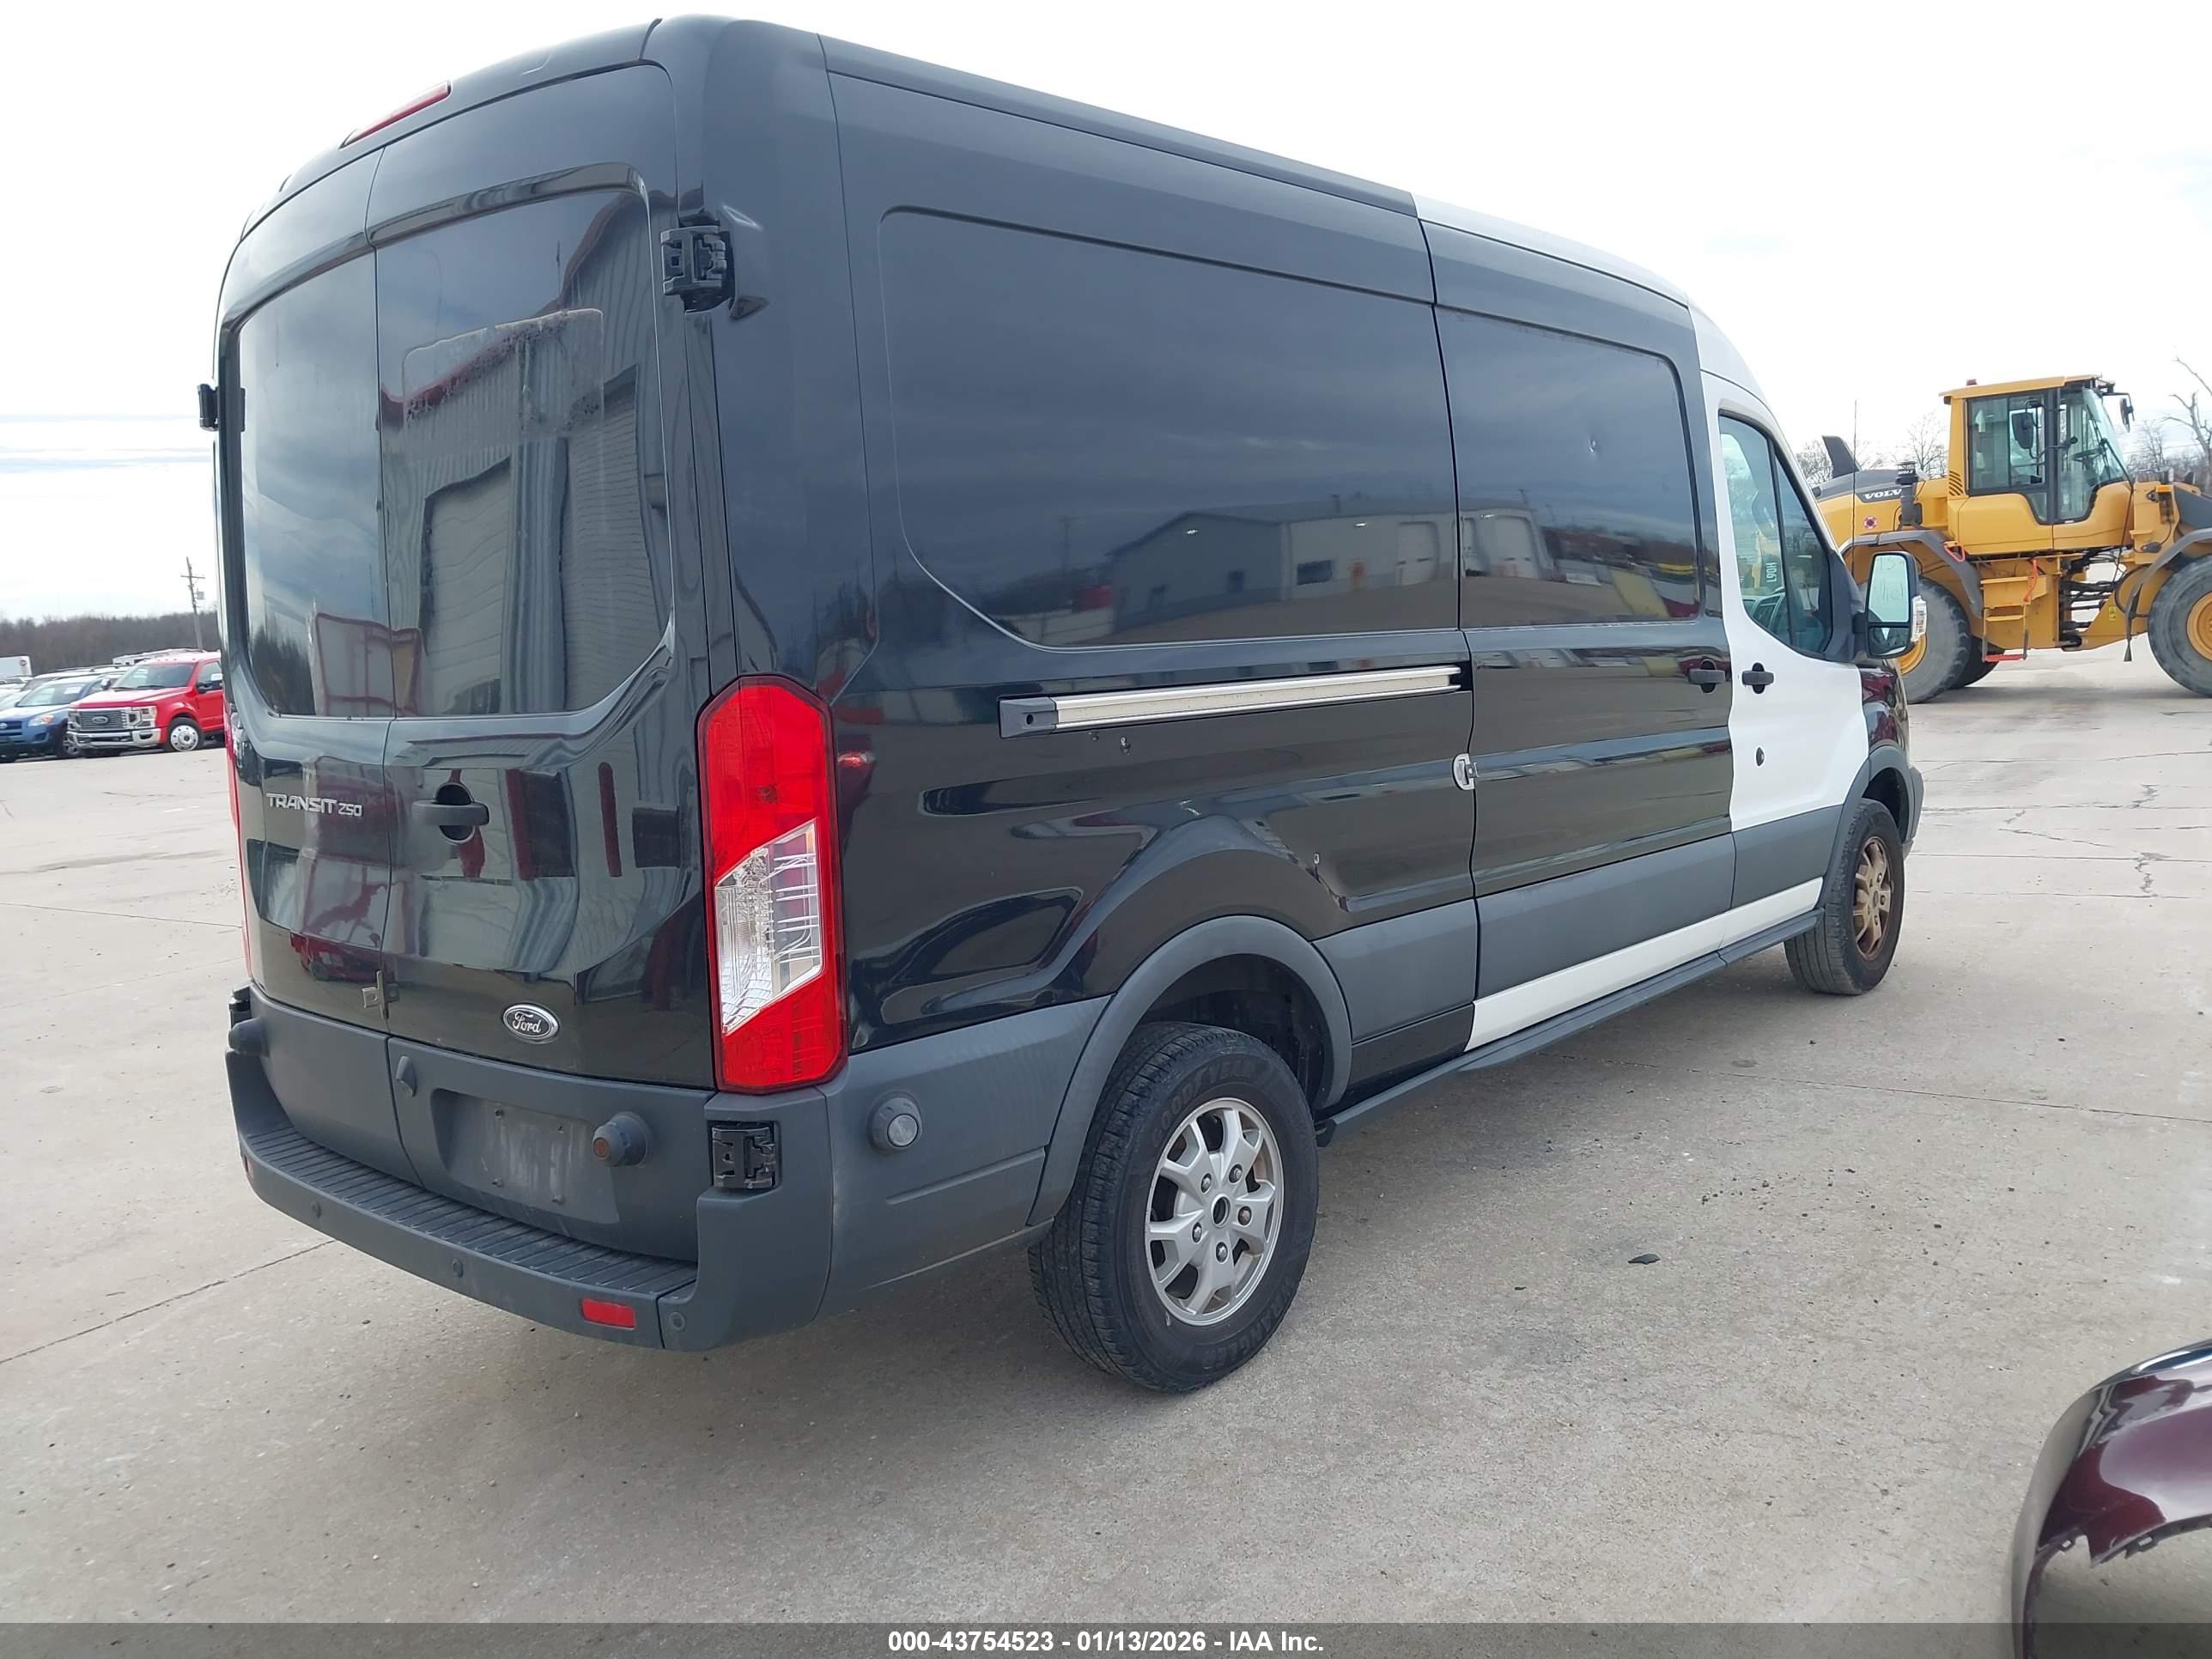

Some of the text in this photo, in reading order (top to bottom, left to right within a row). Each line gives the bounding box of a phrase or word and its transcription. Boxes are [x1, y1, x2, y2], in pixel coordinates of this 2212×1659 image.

[1863, 489, 1903, 500] VOLV
[1765, 562, 1778, 584] L90H
[265, 793, 337, 814] TRANSIT
[337, 802, 363, 817] 250
[512, 1011, 542, 1033] Ford
